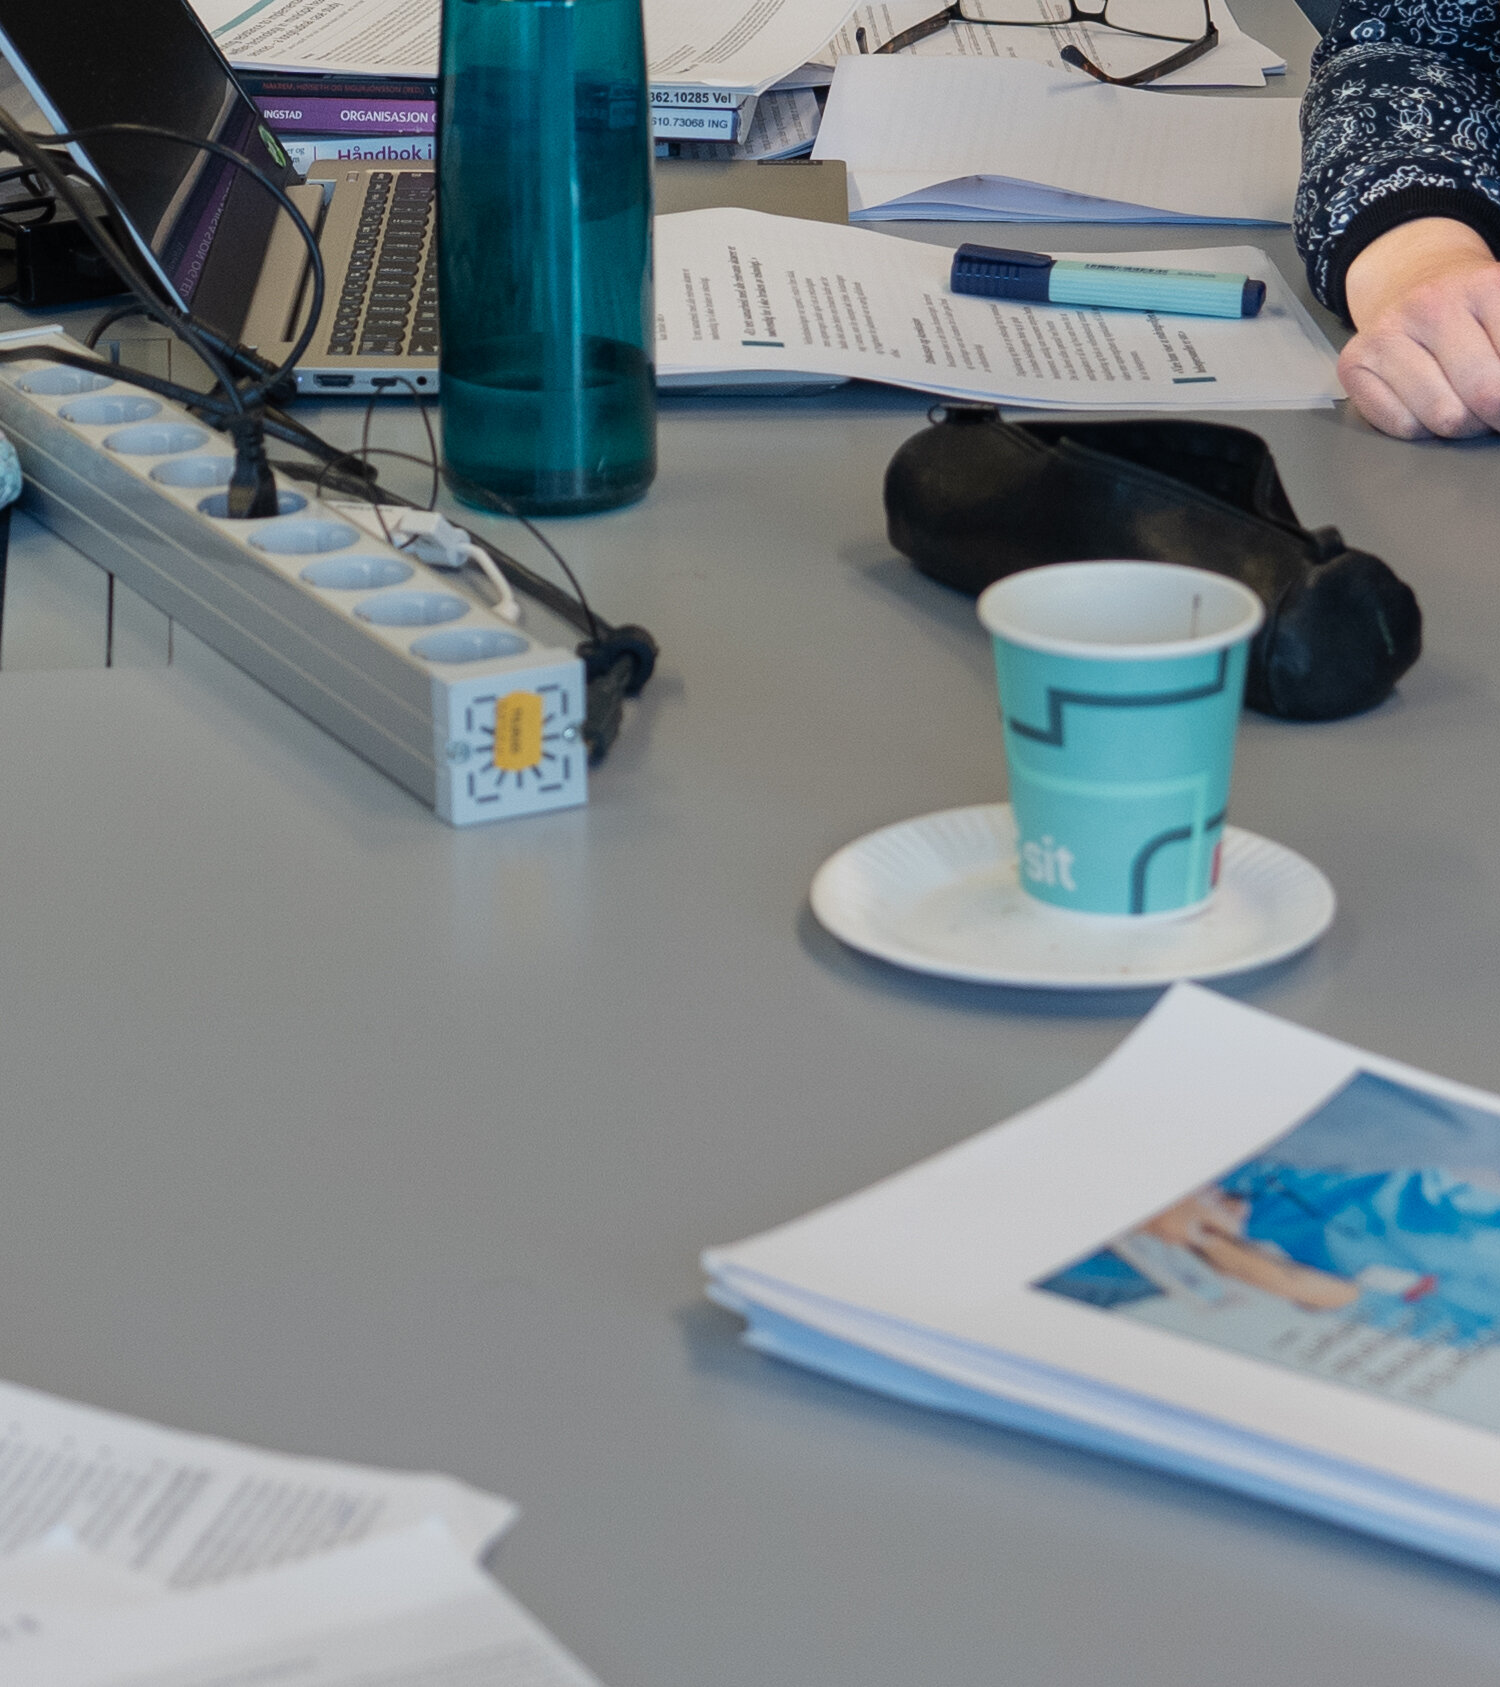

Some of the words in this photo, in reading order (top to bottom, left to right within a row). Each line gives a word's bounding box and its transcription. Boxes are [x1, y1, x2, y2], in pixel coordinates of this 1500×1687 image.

[711, 92, 731, 103] Vel
[263, 109, 303, 120] INGSTAD
[340, 109, 428, 123] ORGANISASJON
[707, 118, 728, 129] ING
[338, 144, 422, 161] Håndbok
